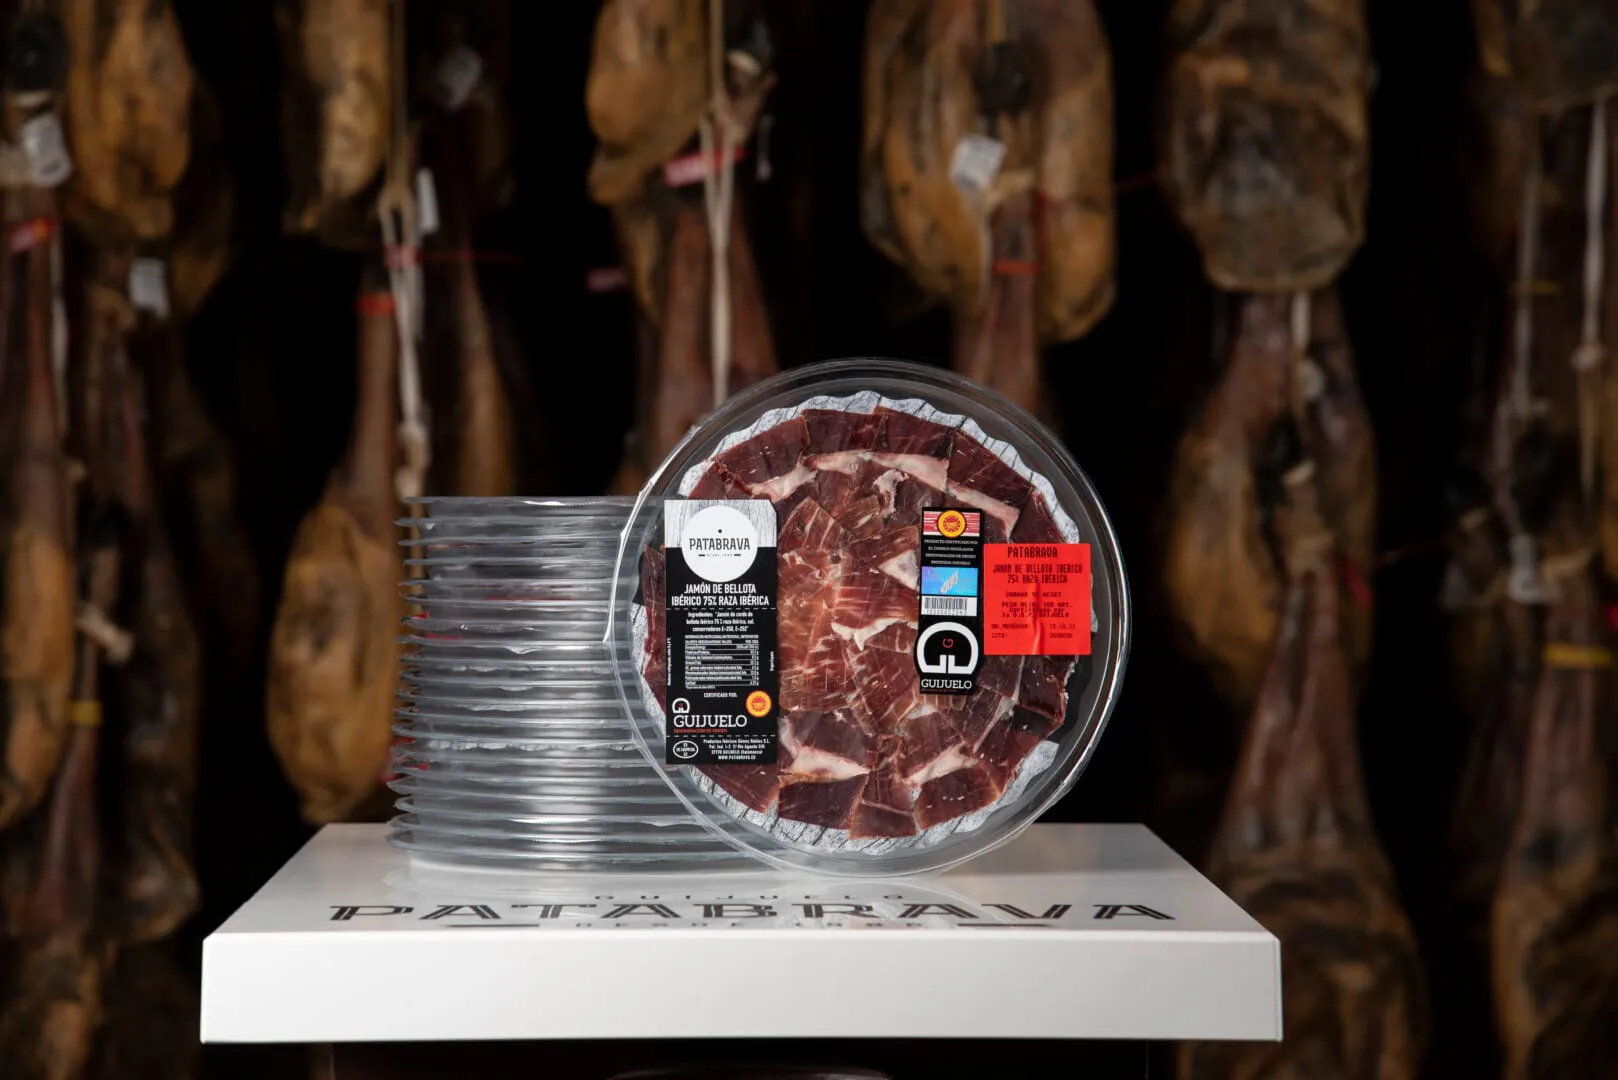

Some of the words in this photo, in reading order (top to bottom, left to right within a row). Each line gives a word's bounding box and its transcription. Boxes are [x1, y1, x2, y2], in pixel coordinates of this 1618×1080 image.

[689, 538, 750, 550] PATABRAVA
[1008, 546, 1058, 558] PATABRAVA
[1015, 564, 1022, 573] DE
[1026, 564, 1052, 573] BELLOTA
[1056, 564, 1082, 573] IBERICO
[1042, 574, 1068, 584] IBERICA
[684, 582, 710, 594] JAMÓN
[712, 584, 722, 594] DE
[724, 584, 756, 594] BELLOTA
[672, 594, 702, 606] IBÉRICO
[704, 596, 717, 605] 75%
[718, 596, 738, 605] RAZA
[740, 594, 769, 605] IBÉRICA
[921, 679, 972, 689] GUIJUELO
[674, 714, 748, 728] GUIJUELO
[329, 904, 1176, 920] PATABRAVA
